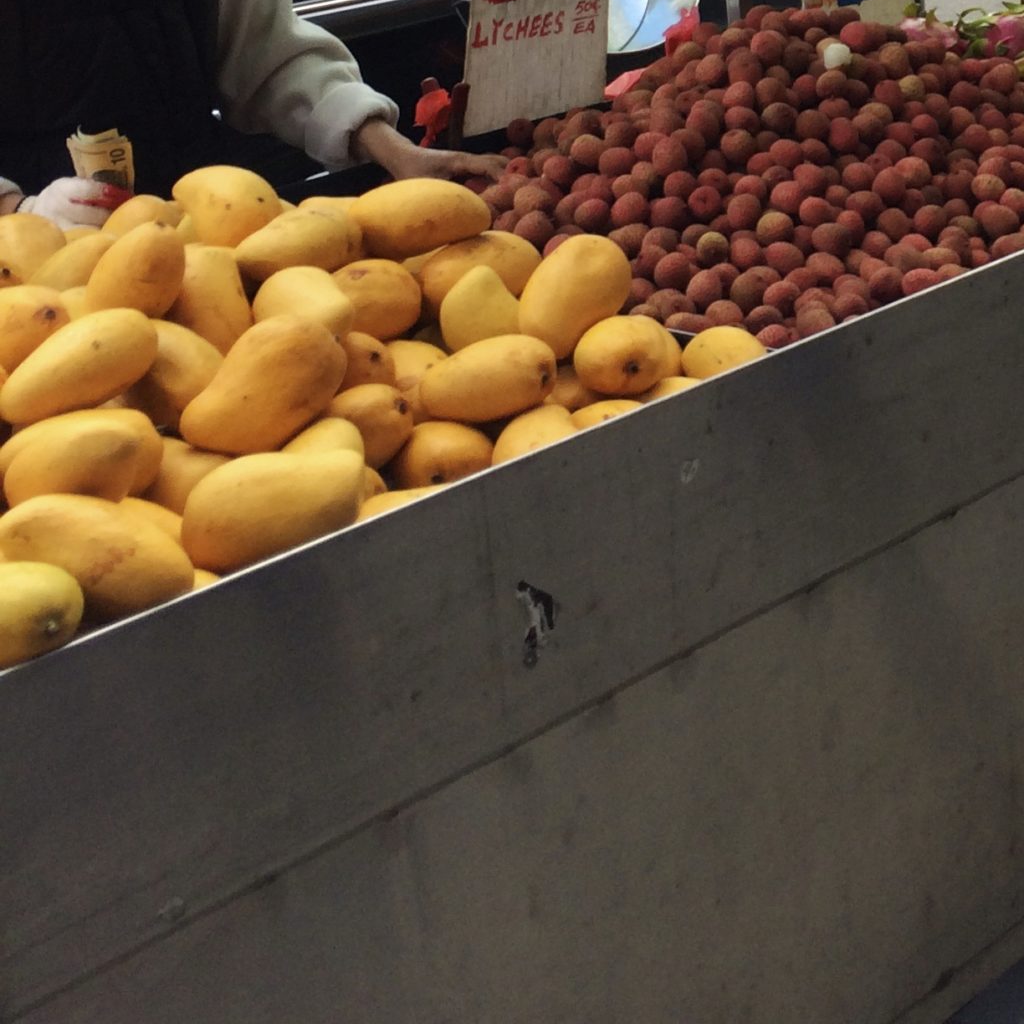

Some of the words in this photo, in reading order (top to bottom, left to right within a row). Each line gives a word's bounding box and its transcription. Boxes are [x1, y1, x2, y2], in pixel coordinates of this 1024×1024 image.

[470, 10, 566, 49] LYCHEES
[573, 21, 597, 34] EA
[110, 148, 126, 164] 10
